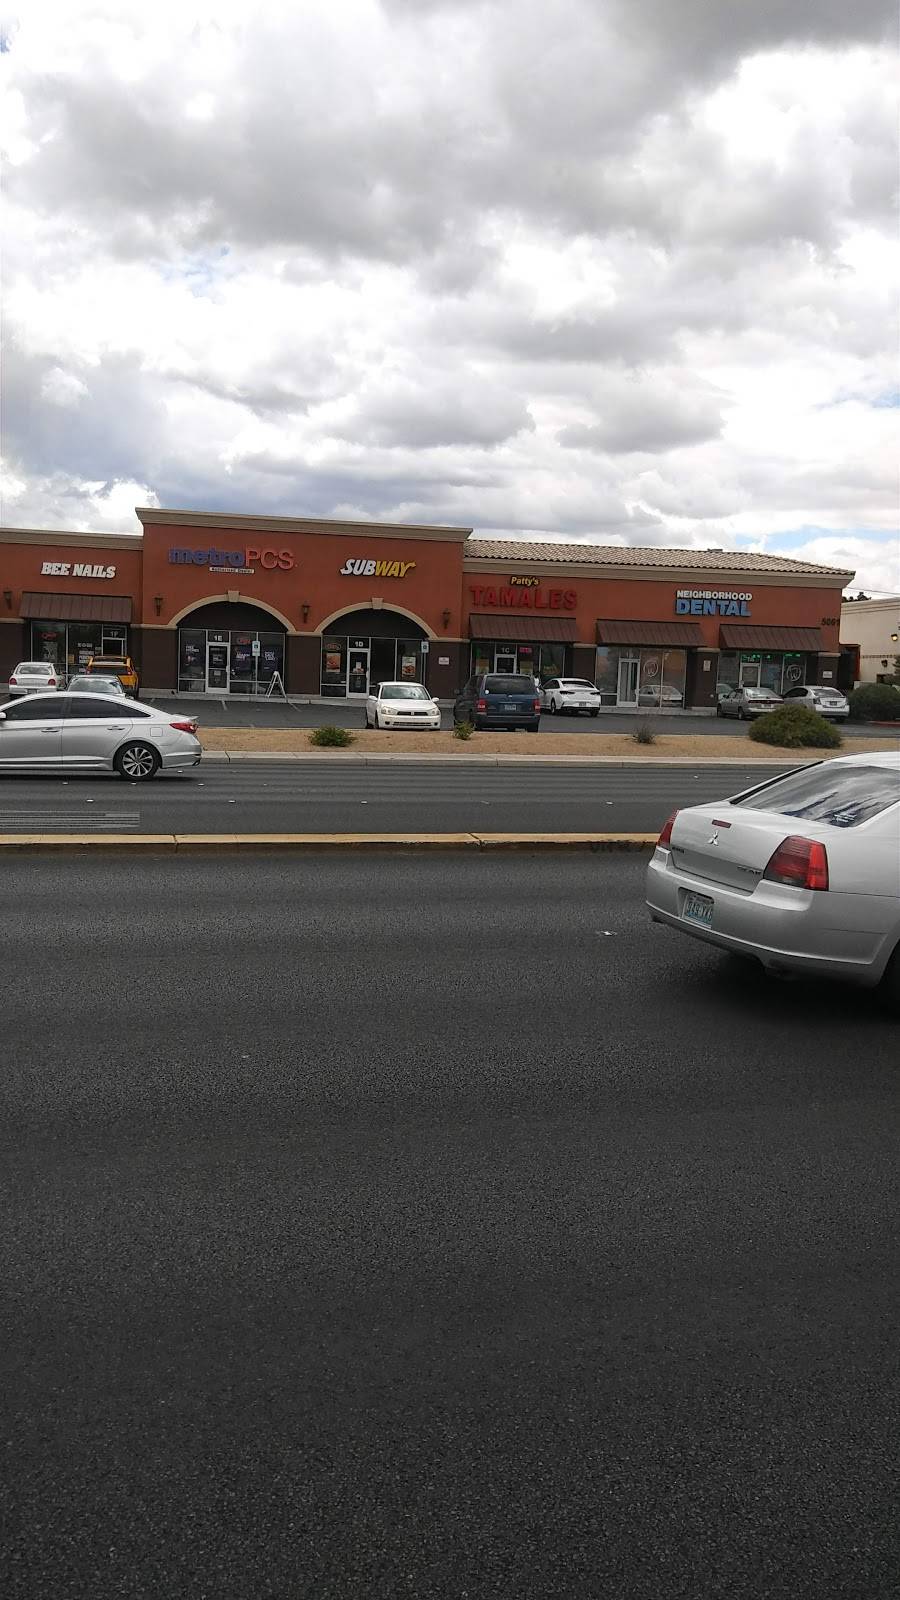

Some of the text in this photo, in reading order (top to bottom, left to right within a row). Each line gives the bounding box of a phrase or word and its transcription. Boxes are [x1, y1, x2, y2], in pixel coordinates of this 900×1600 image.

[168, 546, 295, 570] metroPCS
[41, 562, 116, 579] BEE NAILS
[340, 558, 416, 577] SUBWAY
[510, 576, 539, 586] Patty's
[469, 586, 577, 610] TAMALES
[676, 590, 752, 600] NEIGHBORHOOD
[675, 599, 751, 617] DENTAL
